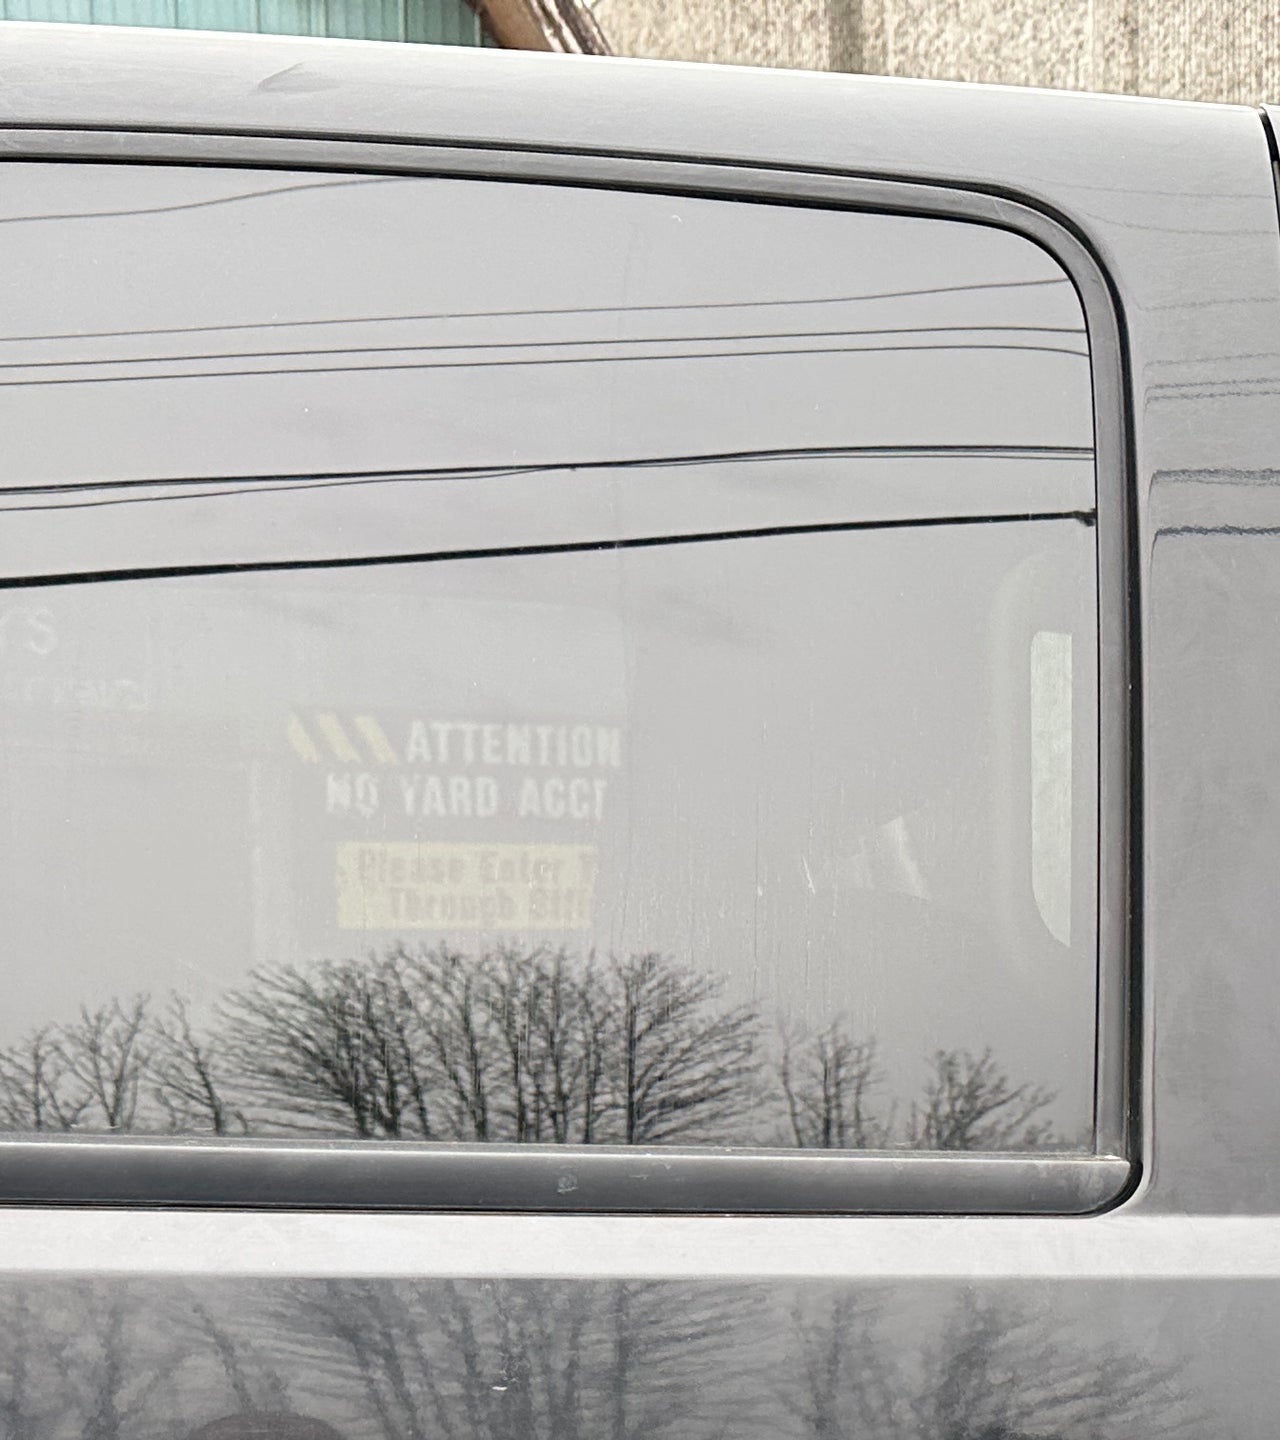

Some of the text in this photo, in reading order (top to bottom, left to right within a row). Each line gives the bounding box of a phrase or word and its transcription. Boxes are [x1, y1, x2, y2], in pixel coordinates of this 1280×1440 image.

[406, 720, 621, 768] ATTENTION
[326, 772, 380, 818] NO
[402, 775, 499, 817] YARD
[359, 848, 466, 884] Please
[479, 850, 564, 884] Enter
[388, 886, 518, 926] Through
